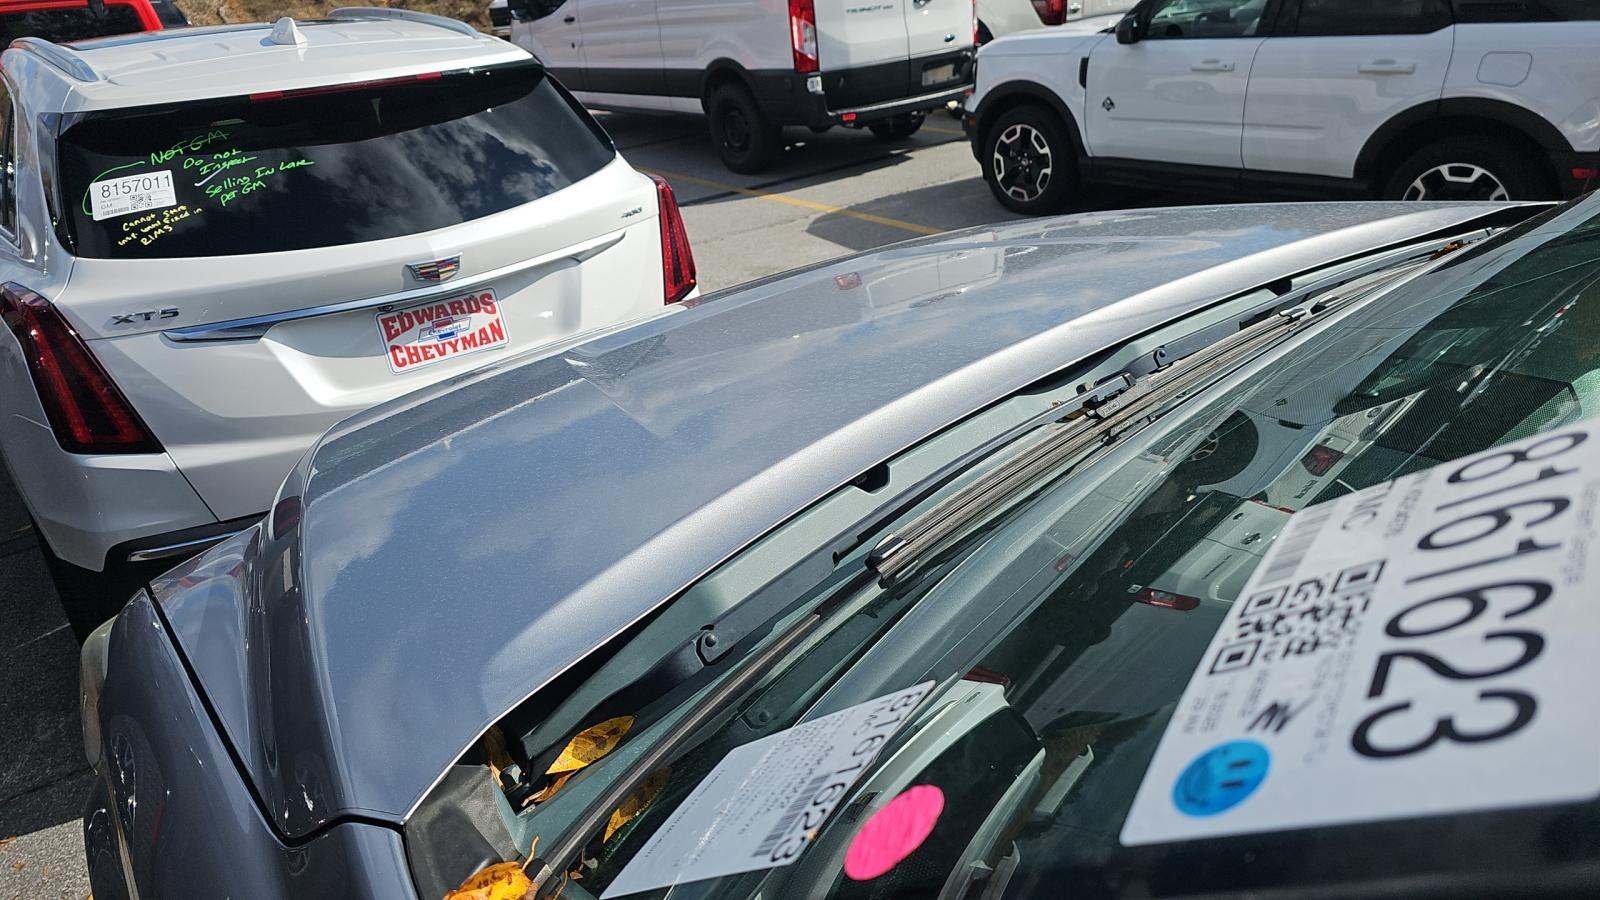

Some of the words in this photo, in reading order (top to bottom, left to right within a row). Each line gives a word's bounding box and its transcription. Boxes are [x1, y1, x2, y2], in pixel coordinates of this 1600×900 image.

[101, 174, 170, 198] 8157011
[111, 307, 179, 326] XT5
[380, 292, 498, 343] EDWARDS
[389, 318, 505, 369] CHEVYMAN
[1351, 431, 1589, 758] 8161623
